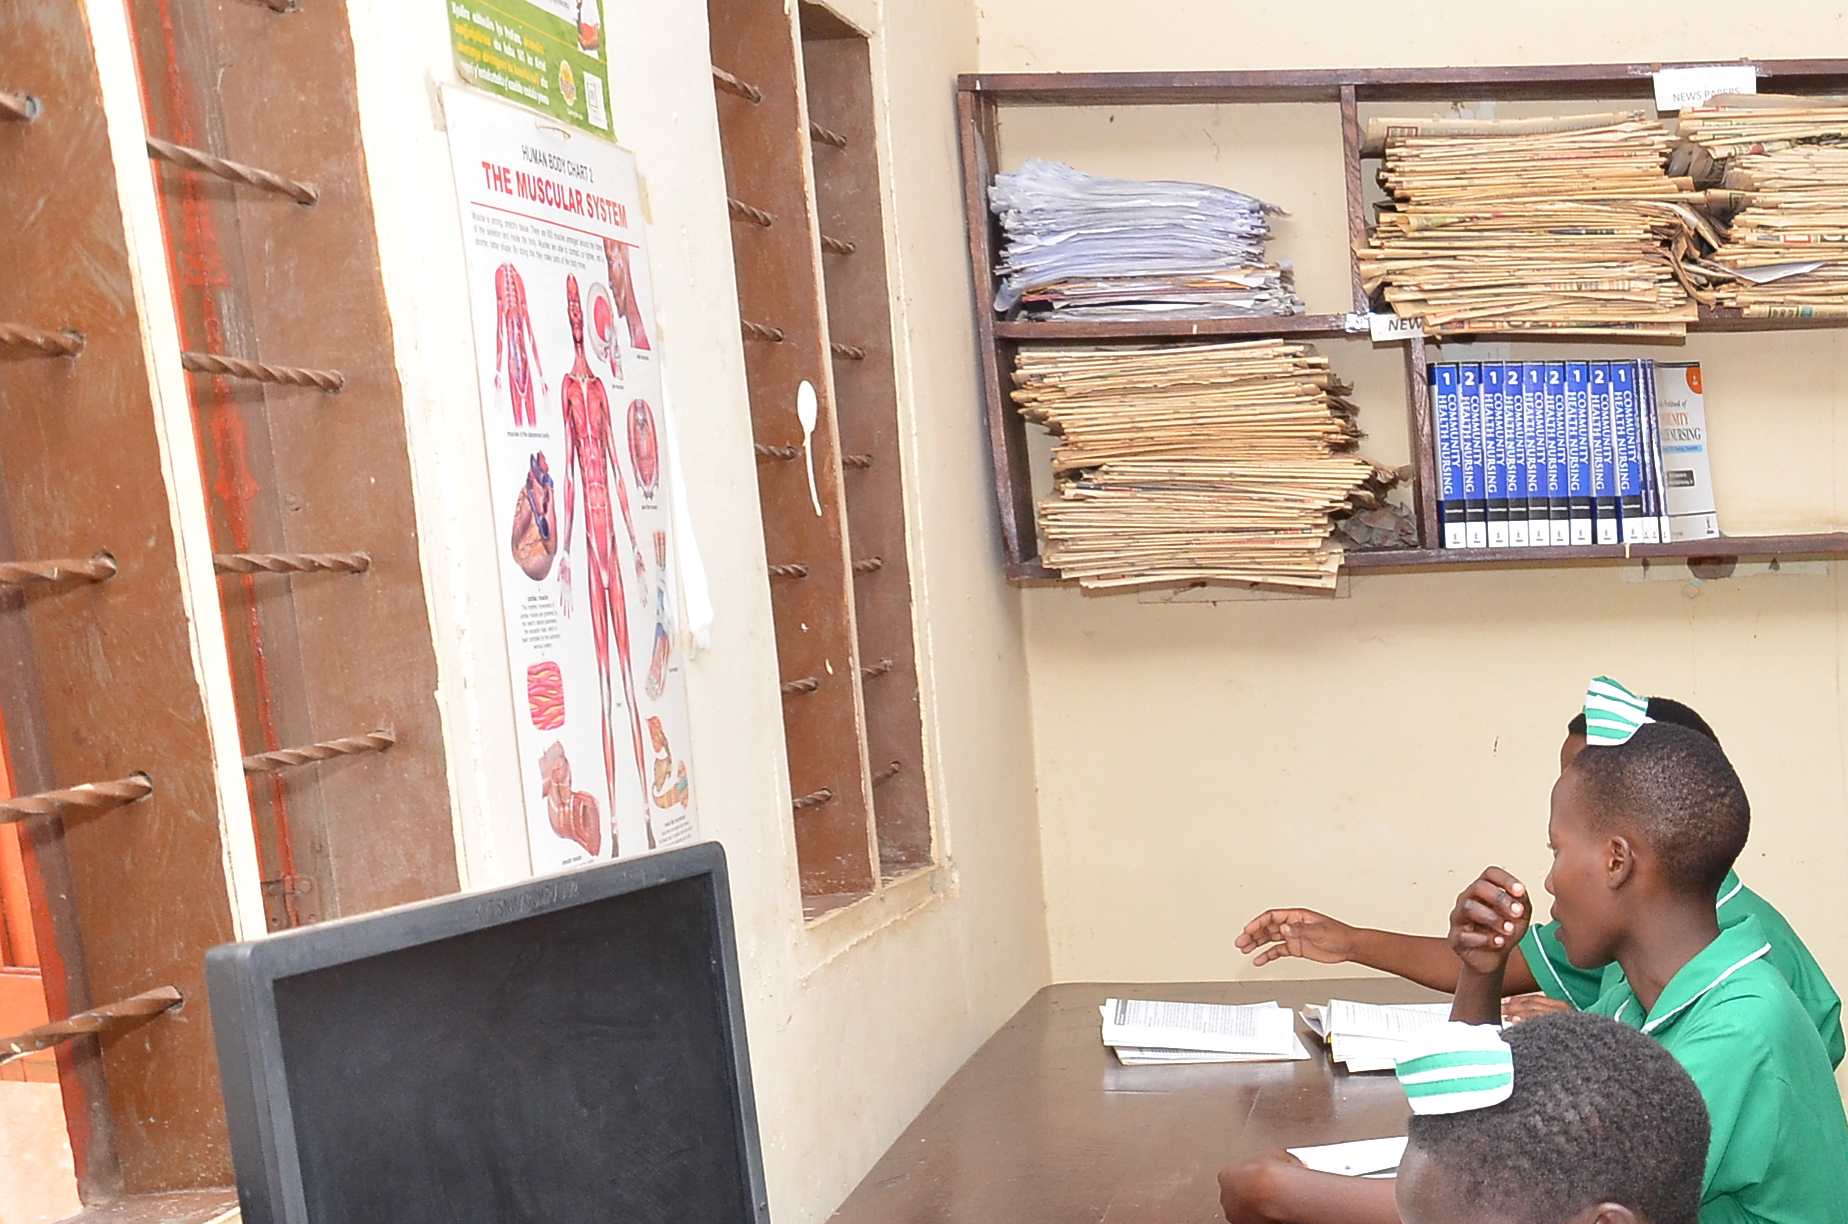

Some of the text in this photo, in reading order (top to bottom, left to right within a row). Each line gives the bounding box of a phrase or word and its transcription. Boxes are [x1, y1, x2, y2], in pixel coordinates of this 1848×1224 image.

[1673, 90, 1702, 102] NEWS
[482, 161, 628, 229] THE MUSCULAR SYSTEM
[521, 145, 547, 166] HUMAN
[549, 153, 566, 174] BODY
[567, 161, 590, 181] CHART
[1443, 372, 1450, 385] 1
[1490, 371, 1497, 384] 1
[1530, 371, 1537, 383] 1
[1595, 371, 1604, 384] 2
[1618, 369, 1626, 381] 1
[1438, 394, 1453, 495] HEALTH NURSING
[1447, 394, 1461, 467] COMMUNITY
[1484, 393, 1497, 493] HEALTH NURSING
[1494, 393, 1505, 466] COMMUNITY
[1525, 393, 1538, 492] HEALTH NURSING
[1534, 392, 1546, 465] COMMUNITY
[1591, 394, 1605, 491] HEALTH NURSING
[1600, 394, 1612, 465] COMMUNITY
[1614, 392, 1630, 490] HEALTH NURSING
[1623, 391, 1637, 464] COMMUNITY
